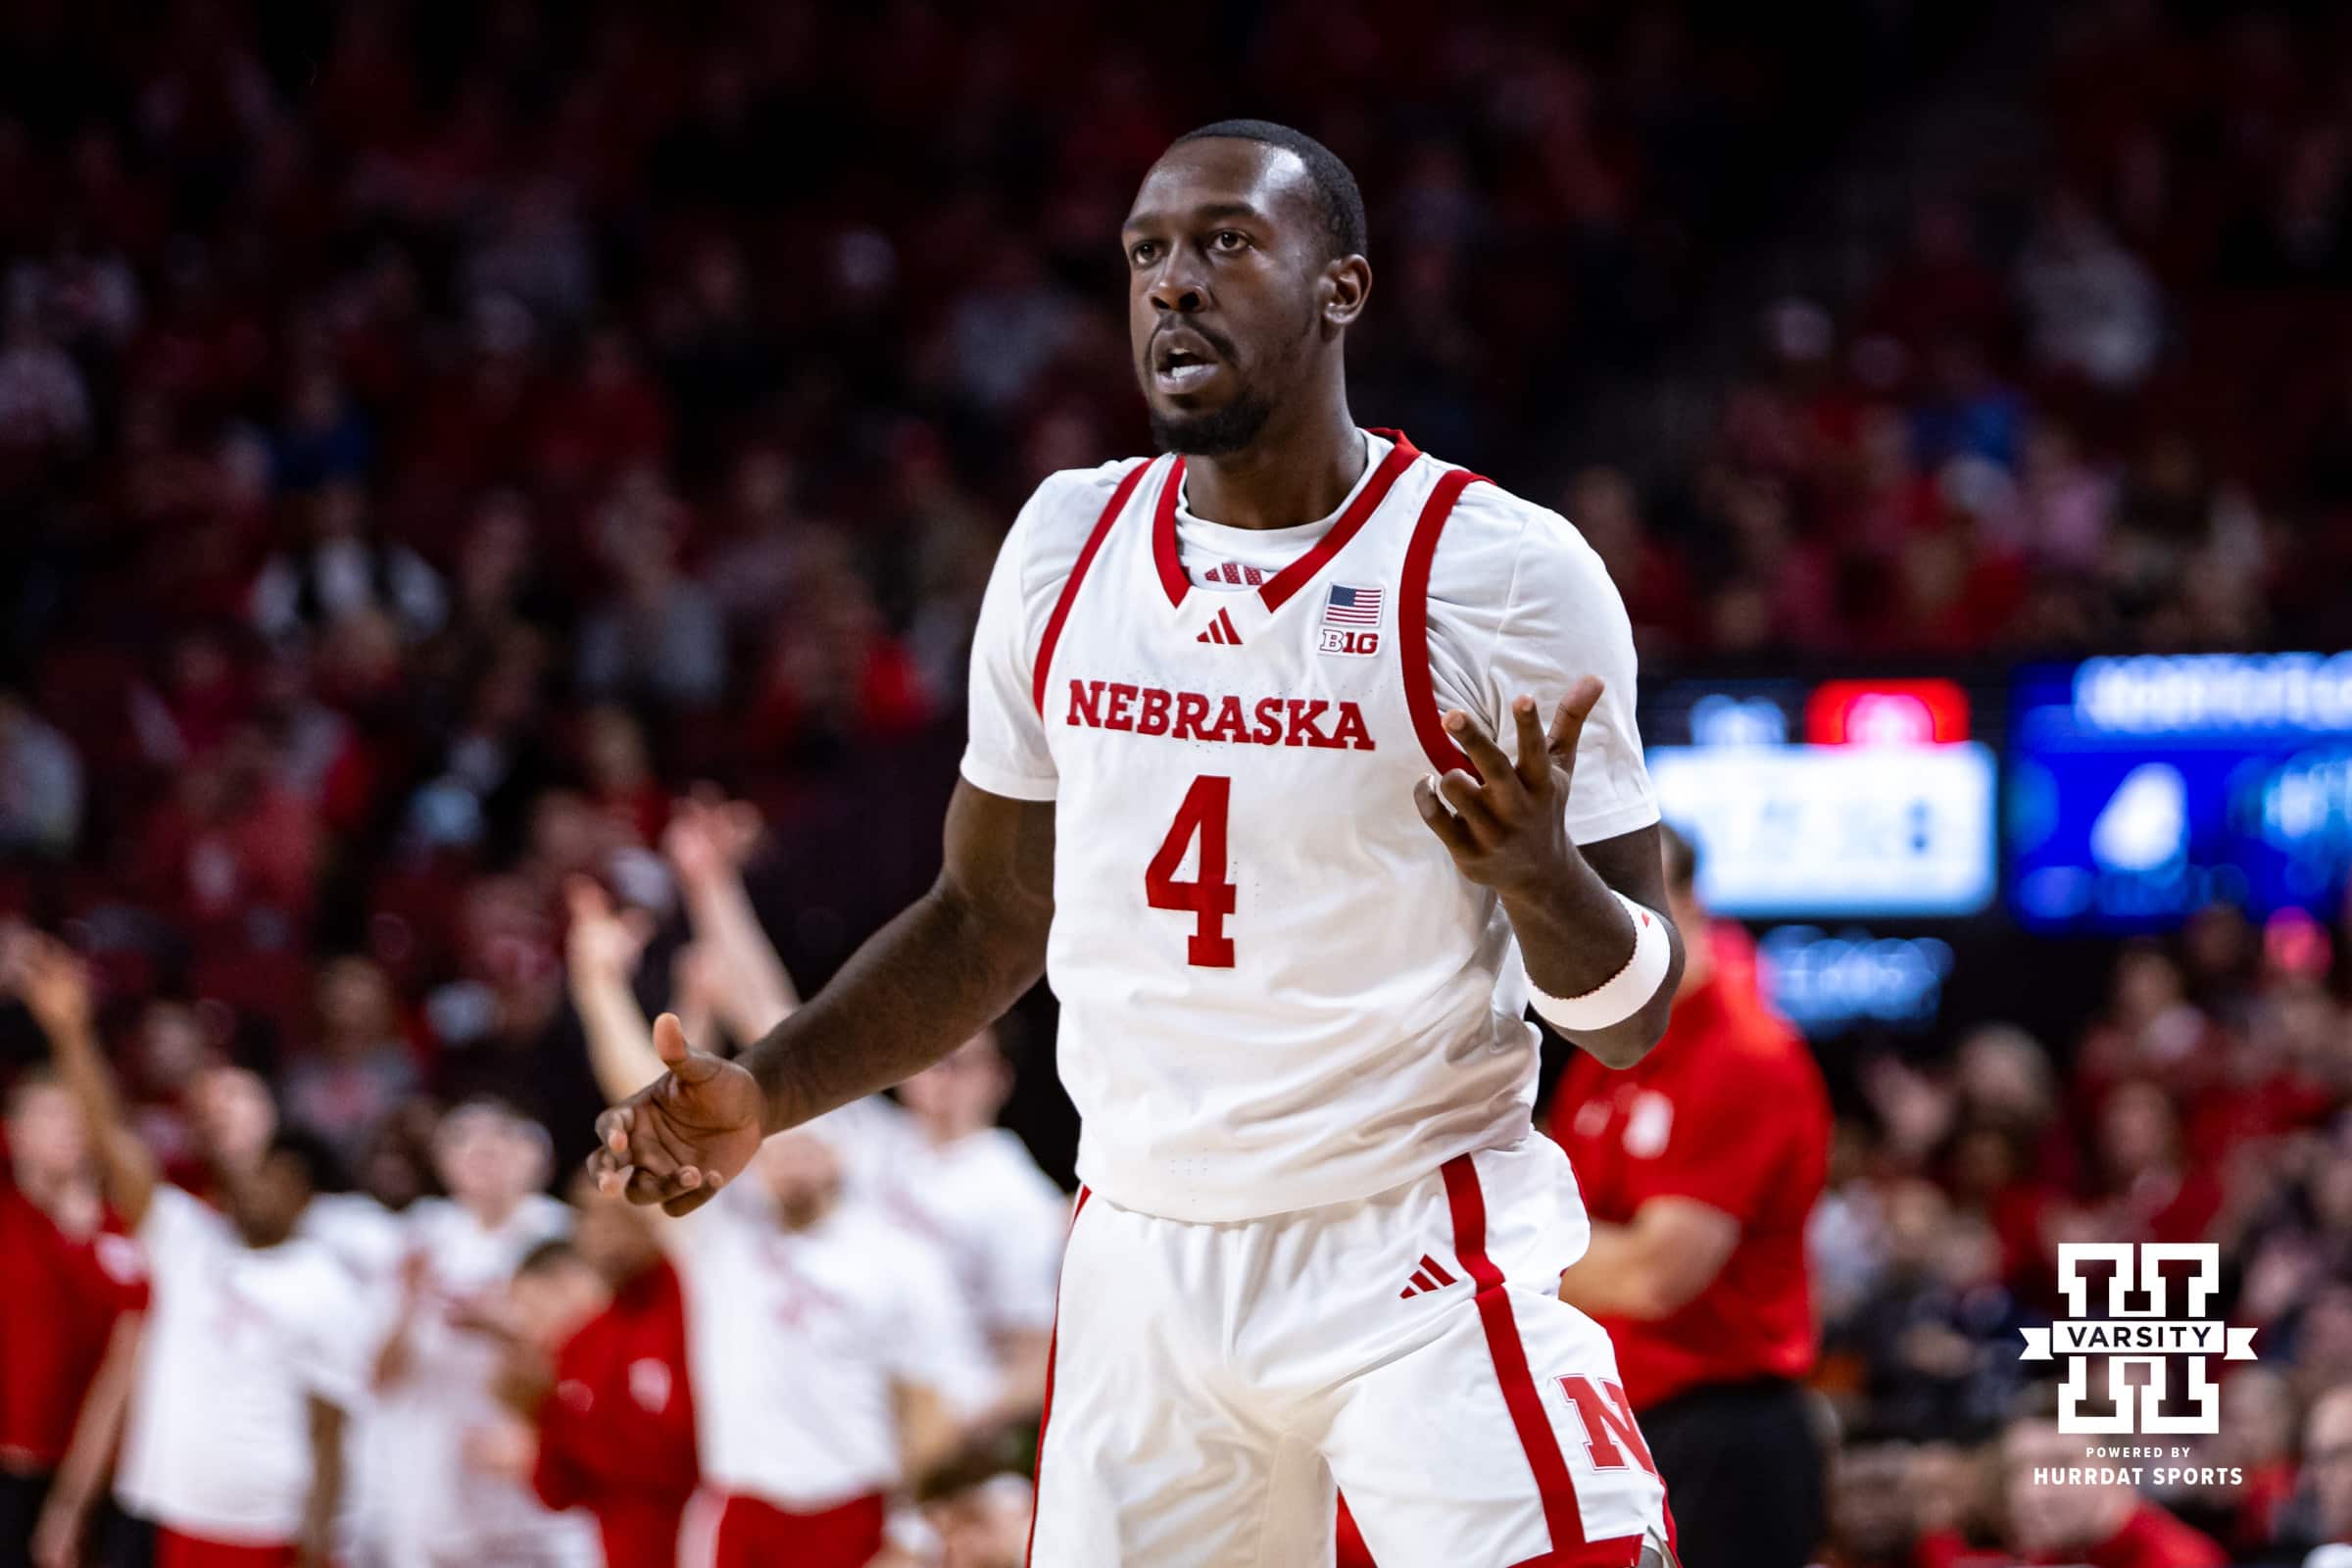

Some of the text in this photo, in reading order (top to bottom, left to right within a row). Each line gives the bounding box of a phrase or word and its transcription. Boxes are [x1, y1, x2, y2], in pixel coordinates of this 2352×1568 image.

[1066, 679, 1375, 752] NEBRASKA
[1145, 774, 1237, 968] 4
[1553, 1373, 1658, 1476] N
